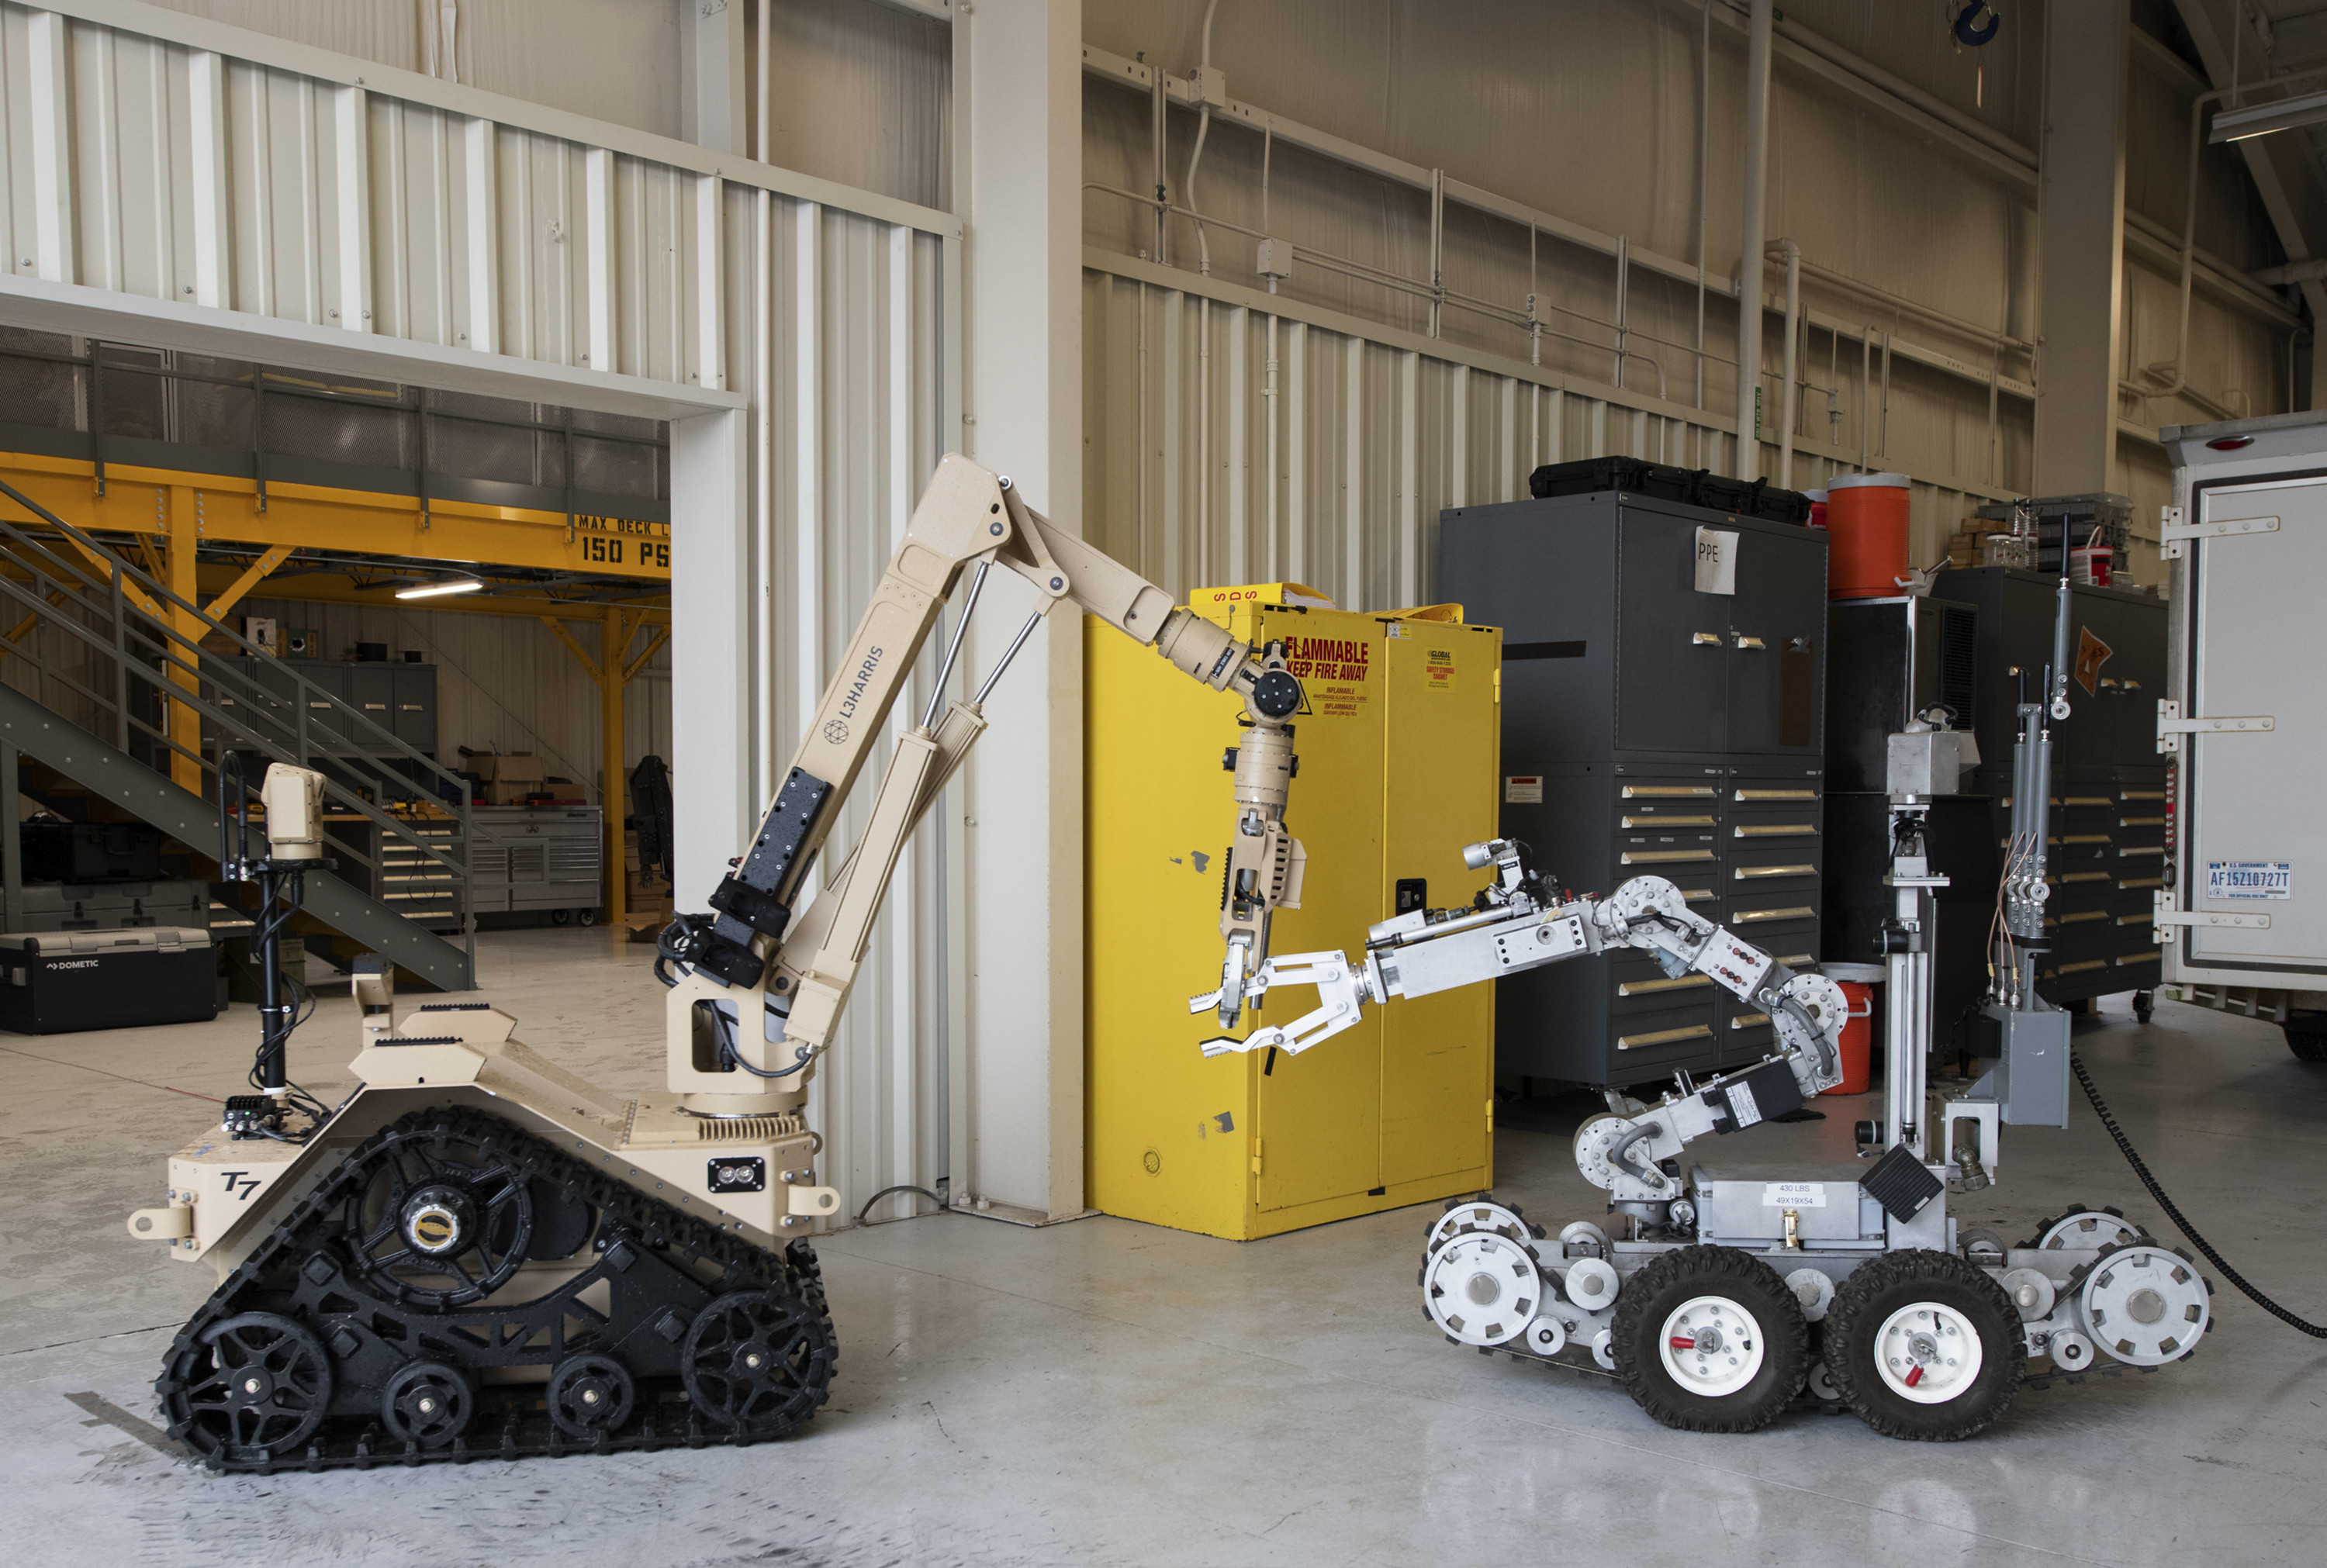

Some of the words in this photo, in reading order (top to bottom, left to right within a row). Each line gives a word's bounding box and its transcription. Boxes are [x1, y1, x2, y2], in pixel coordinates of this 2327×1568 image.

[579, 515, 607, 530] MAX
[617, 519, 651, 534] DECK
[583, 537, 622, 564] 150
[1699, 542, 1719, 563] PPE
[1285, 636, 1369, 665] FLAMMABLE
[1286, 660, 1312, 679] KEEP
[1314, 662, 1338, 679] FIRE
[1338, 664, 1368, 682] AWAY
[838, 645, 883, 719] L3HARRIS
[1326, 686, 1355, 695] INFLAMABLE
[2210, 872, 2289, 887] AF15Z10727T
[59, 960, 99, 969] DOMETIC
[220, 1171, 262, 1200] T7
[1776, 1197, 1814, 1205] 49X19X54
